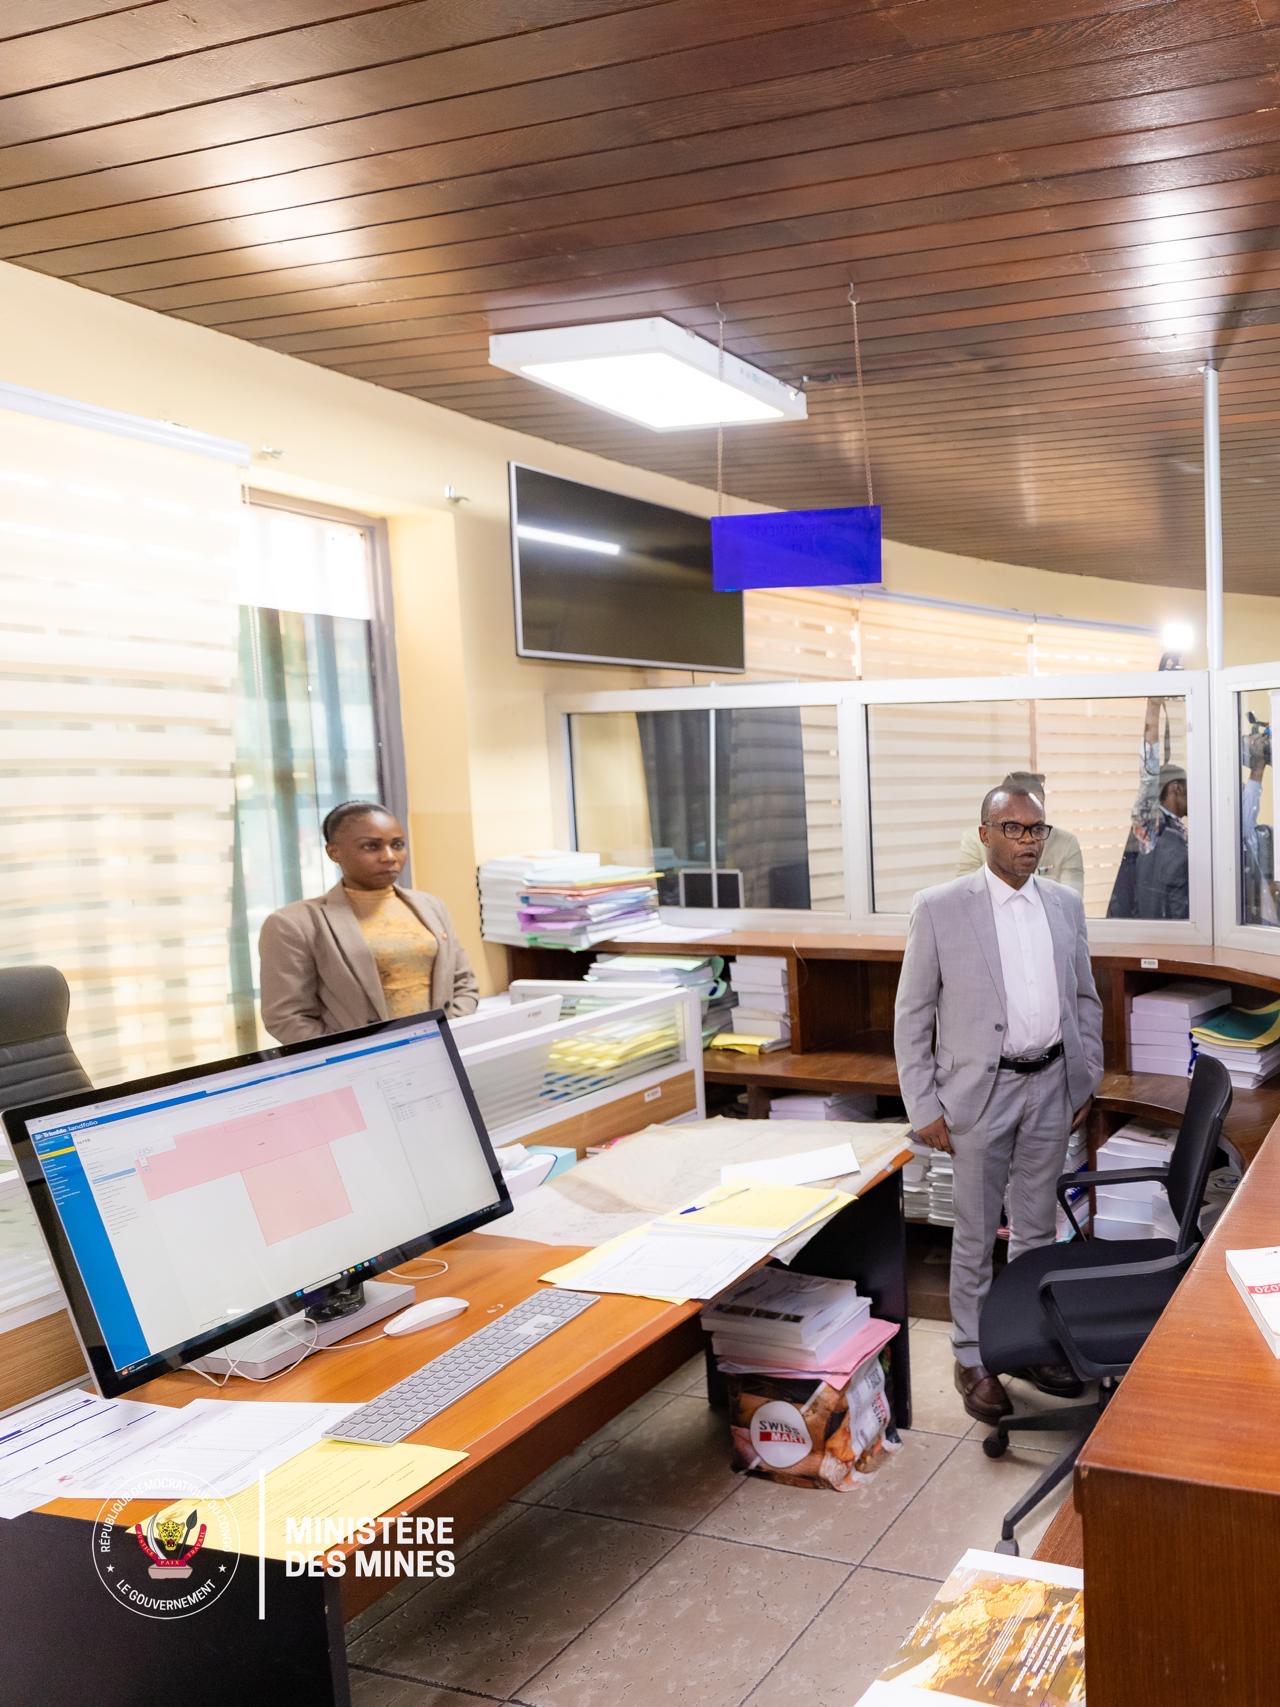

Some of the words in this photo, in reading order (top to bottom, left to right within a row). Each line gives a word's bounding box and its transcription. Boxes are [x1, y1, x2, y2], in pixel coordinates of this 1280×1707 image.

[42, 1128, 67, 1138] Trimble
[67, 1120, 98, 1132] landfolio
[759, 1420, 799, 1433] SWISS
[771, 1430, 807, 1442] MART
